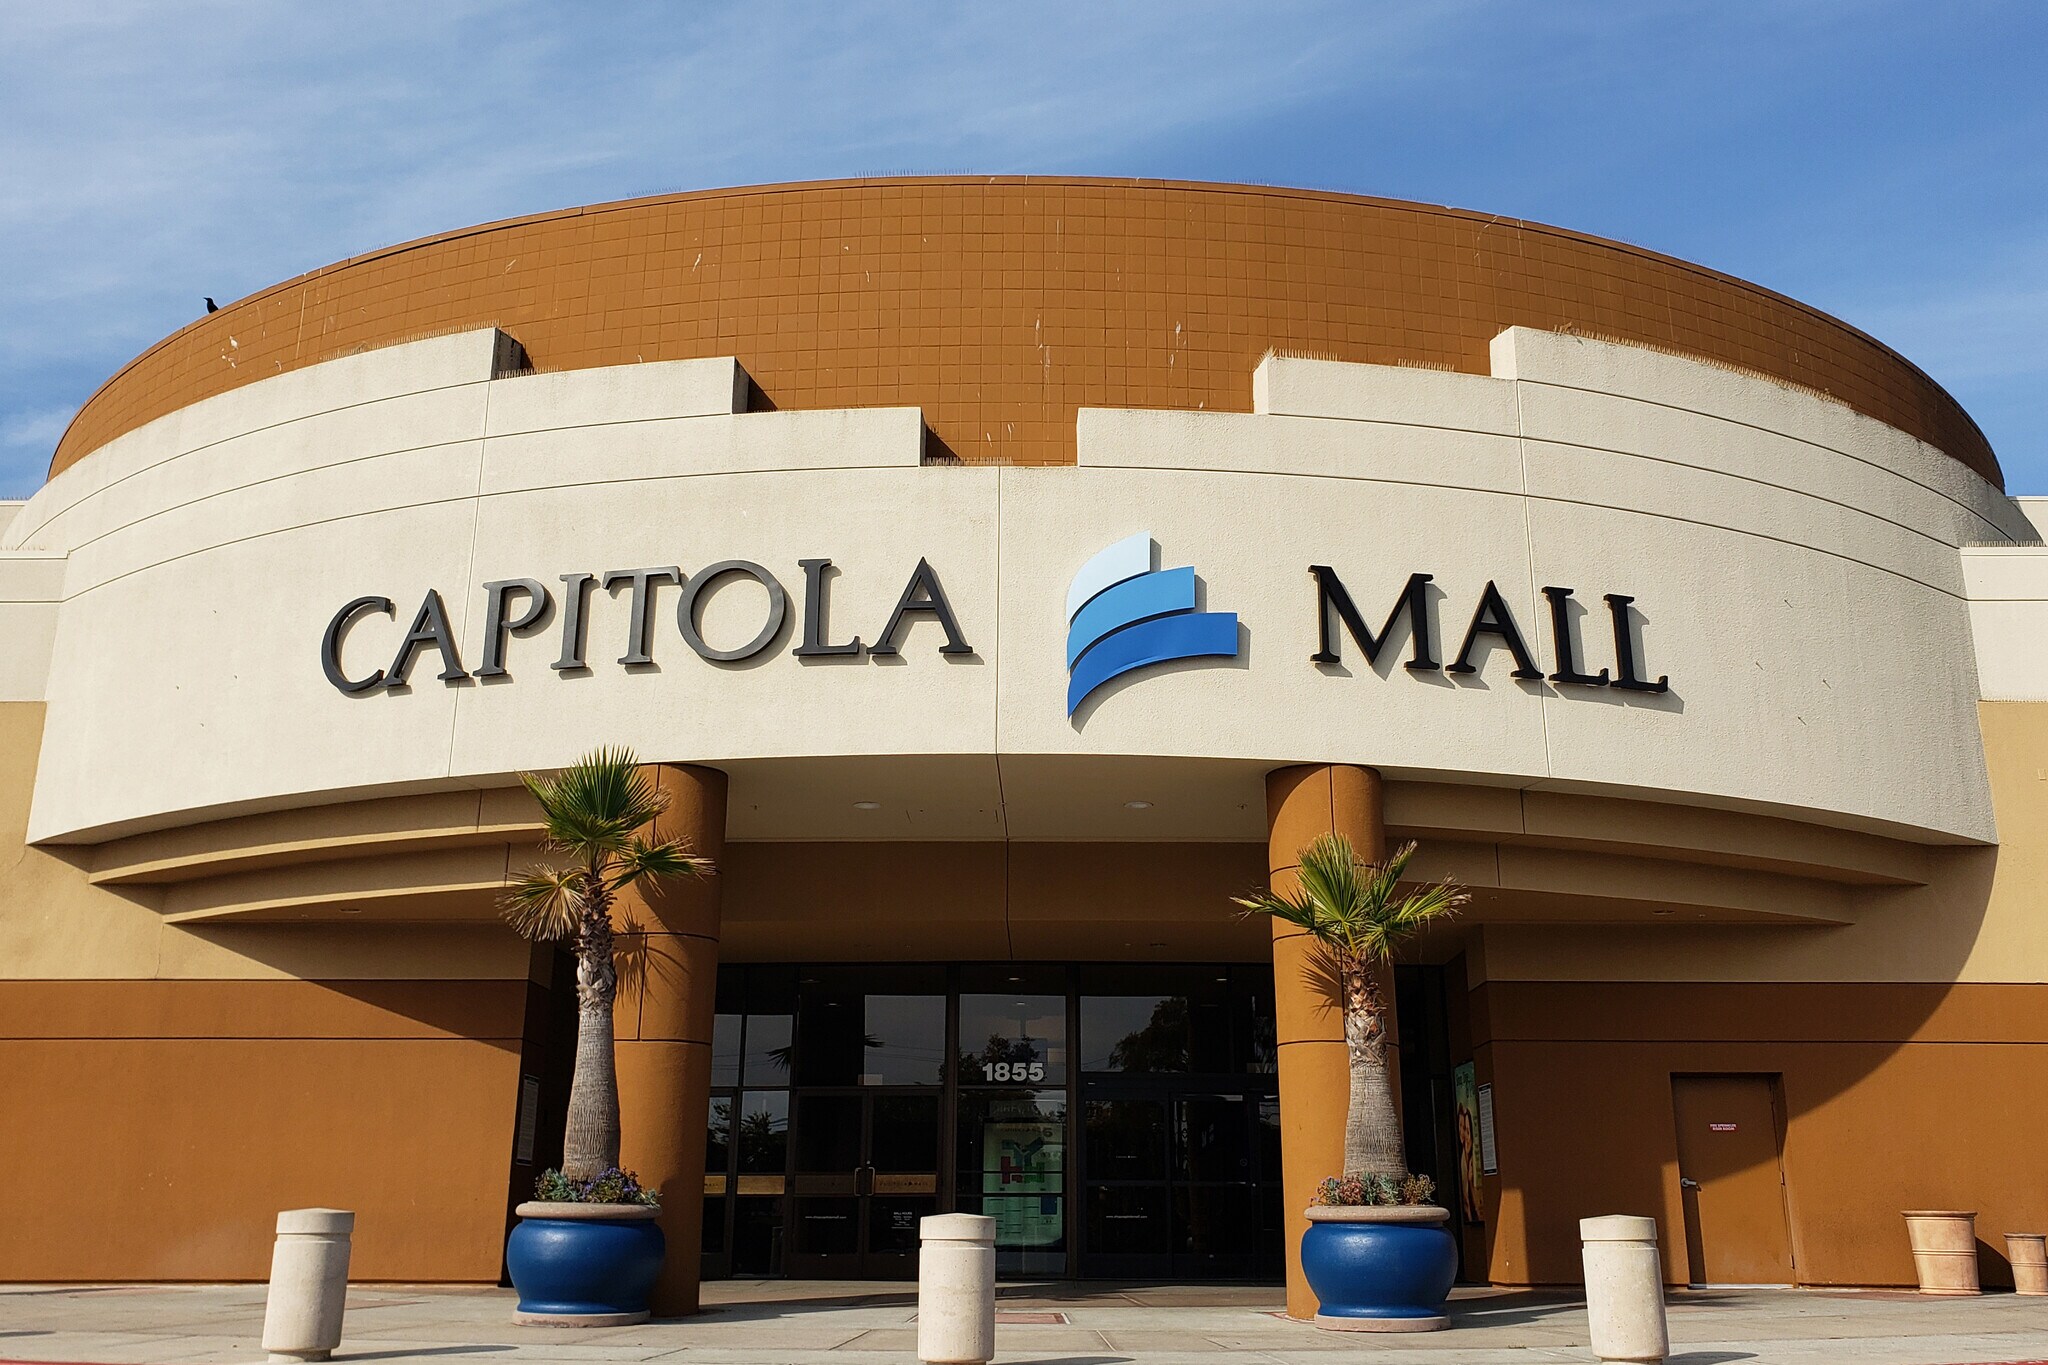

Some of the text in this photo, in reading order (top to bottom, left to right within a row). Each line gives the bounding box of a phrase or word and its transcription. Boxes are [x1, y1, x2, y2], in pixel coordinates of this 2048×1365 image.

[321, 556, 1668, 693] CAPITOLA MALL
[982, 1062, 1044, 1082] 1855
